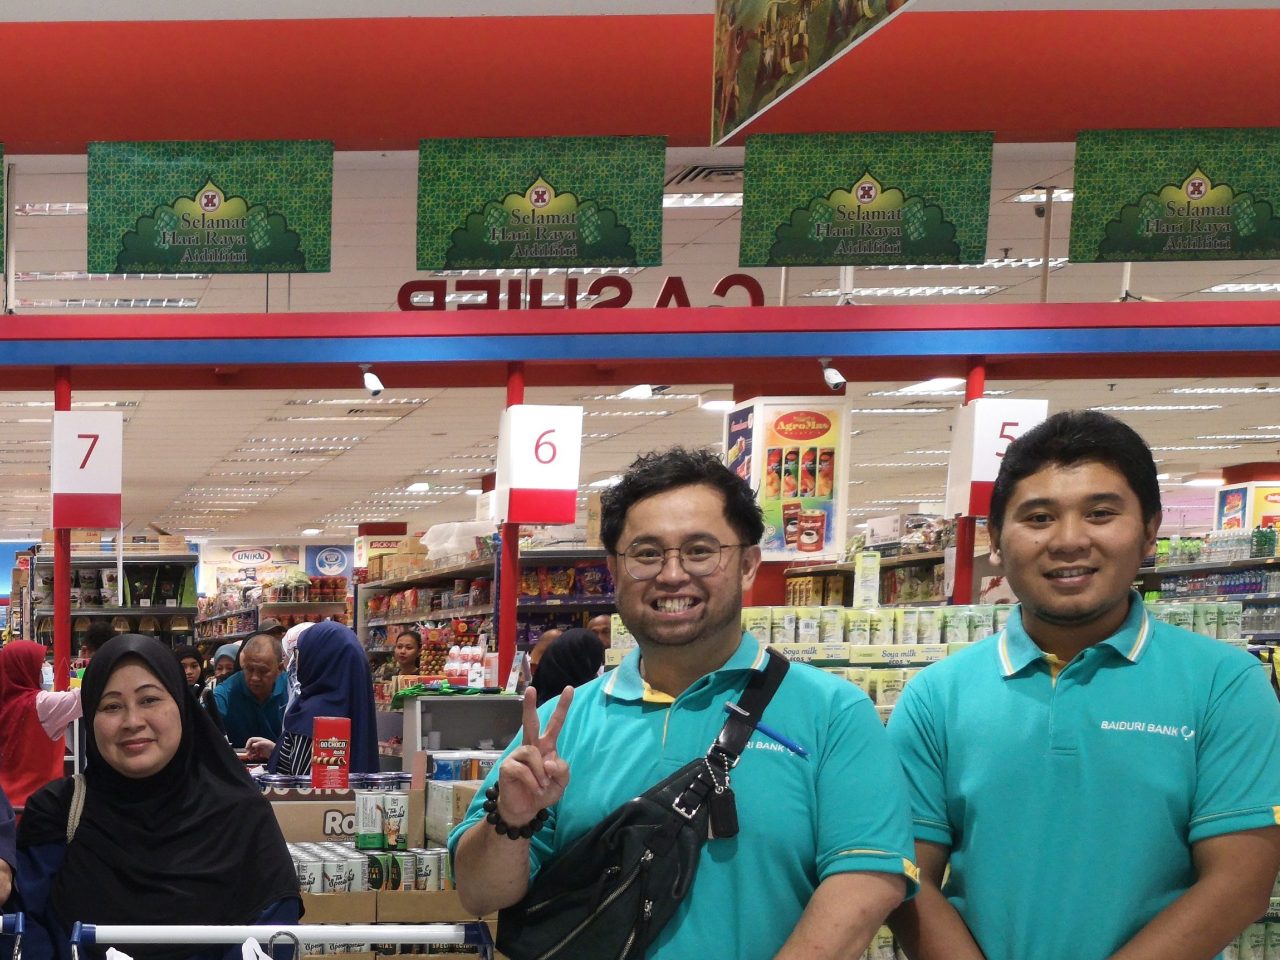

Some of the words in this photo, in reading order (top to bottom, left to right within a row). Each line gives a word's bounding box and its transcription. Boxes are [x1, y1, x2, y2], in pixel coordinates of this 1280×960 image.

[510, 208, 577, 225] Selamat
[836, 203, 902, 220] Selamat
[1166, 200, 1232, 217] Selamat
[181, 212, 248, 229] Selamat
[1145, 218, 1185, 234] Hari
[1189, 219, 1232, 236] Raya
[490, 226, 530, 242] Hari
[533, 227, 577, 243] Raya
[815, 221, 856, 237] Hari
[859, 221, 902, 238] Raya
[161, 230, 201, 246] Hari
[205, 231, 247, 247] Raya
[833, 238, 901, 255] Aidilfitri
[1163, 235, 1232, 251] Aidilfitri
[181, 247, 247, 263] Aidilfitri
[511, 242, 577, 258] Aidilfitri
[534, 428, 557, 464] 6
[995, 422, 1020, 458] 5
[77, 434, 100, 470] 7
[782, 646, 799, 658] Soya
[801, 647, 817, 655] milk
[881, 649, 897, 661] Soya
[899, 650, 916, 658] milk
[1101, 720, 1146, 731] BAIDURI
[1147, 723, 1179, 736] BANK
[756, 741, 785, 753] BANK
